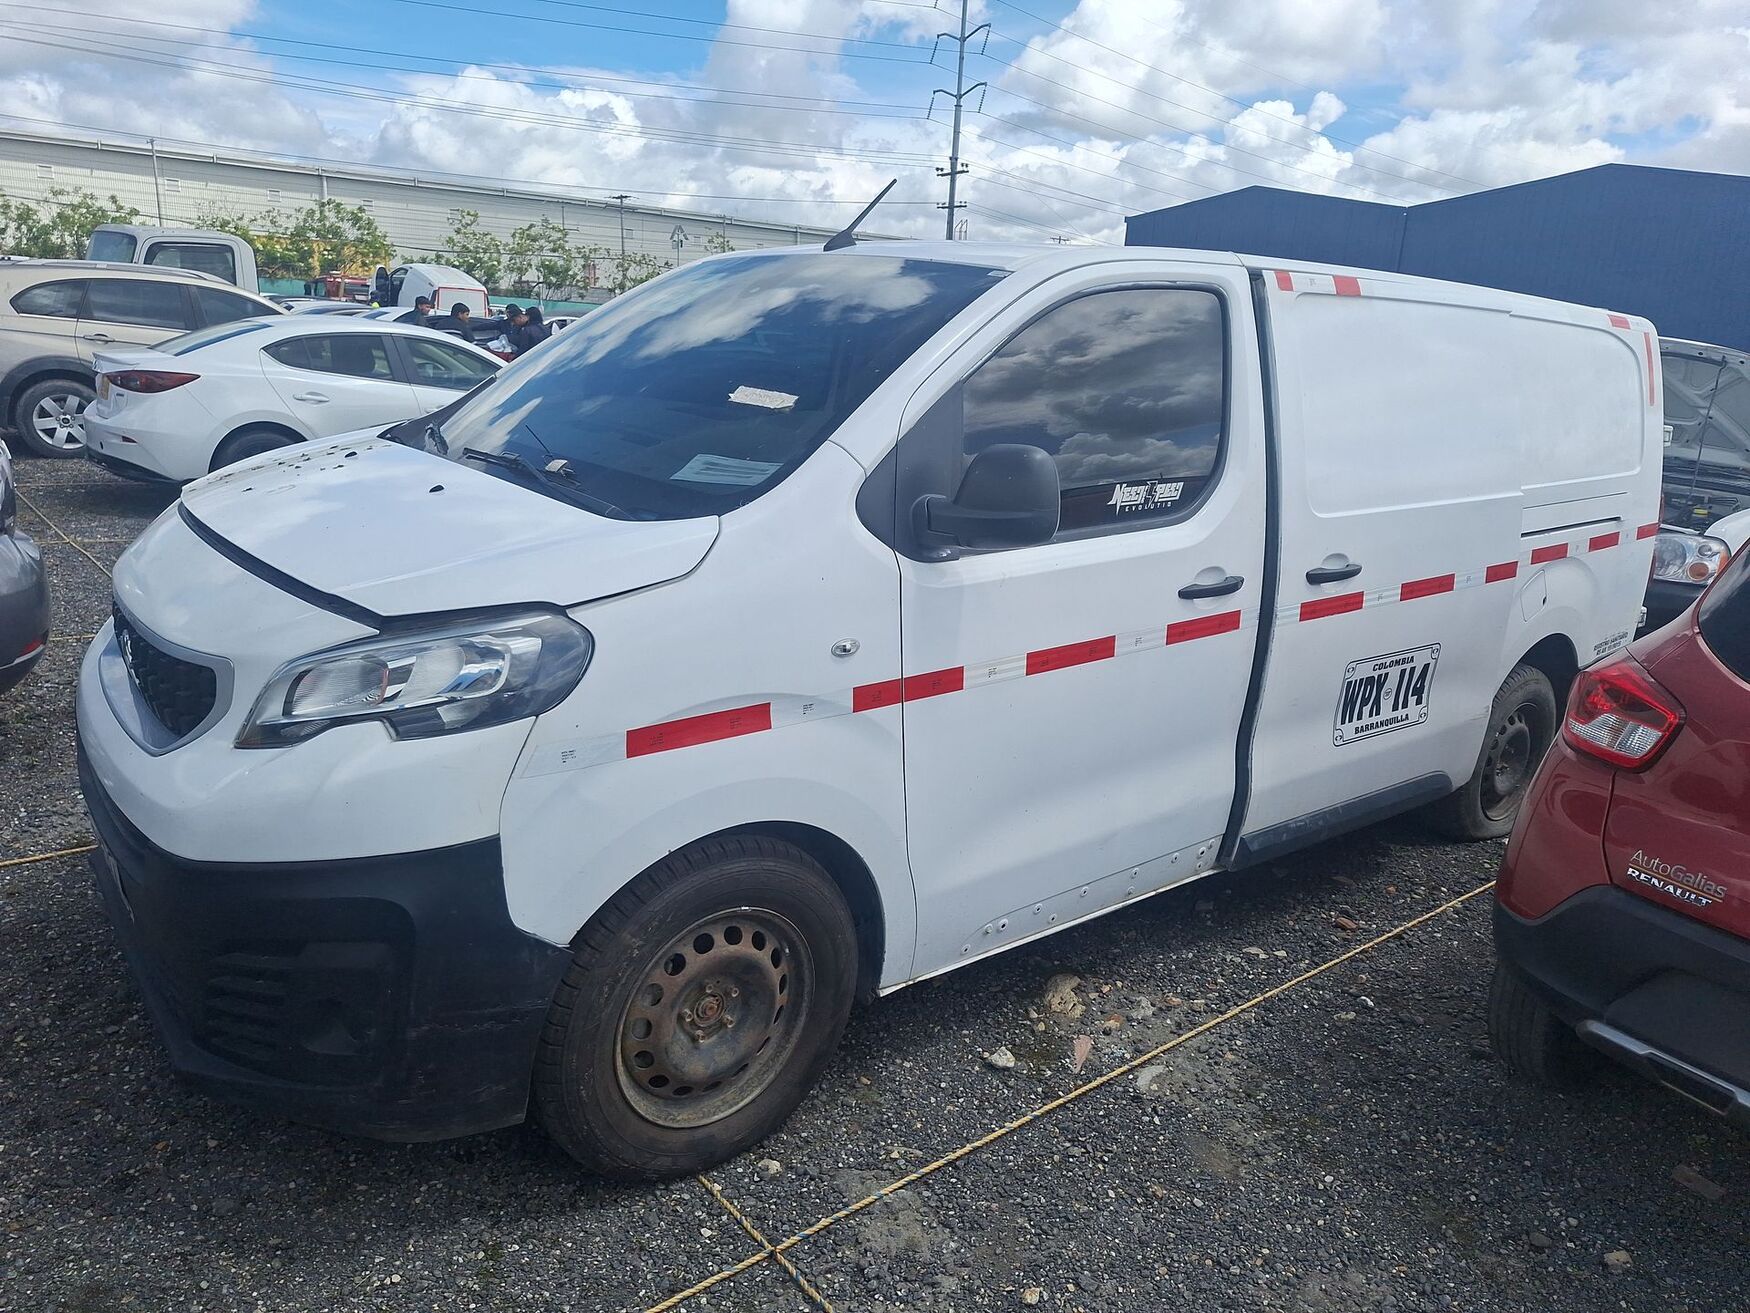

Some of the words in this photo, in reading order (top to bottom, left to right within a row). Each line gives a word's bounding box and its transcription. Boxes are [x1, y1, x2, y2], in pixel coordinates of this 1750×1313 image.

[1372, 656, 1415, 672] COLOMBIA
[1340, 672, 1390, 725] WPX
[1392, 663, 1430, 712] 114
[1354, 714, 1409, 734] BARRANQUILLA
[1626, 867, 1712, 907] RENAULT
[1629, 849, 1727, 898] AutoGalias
